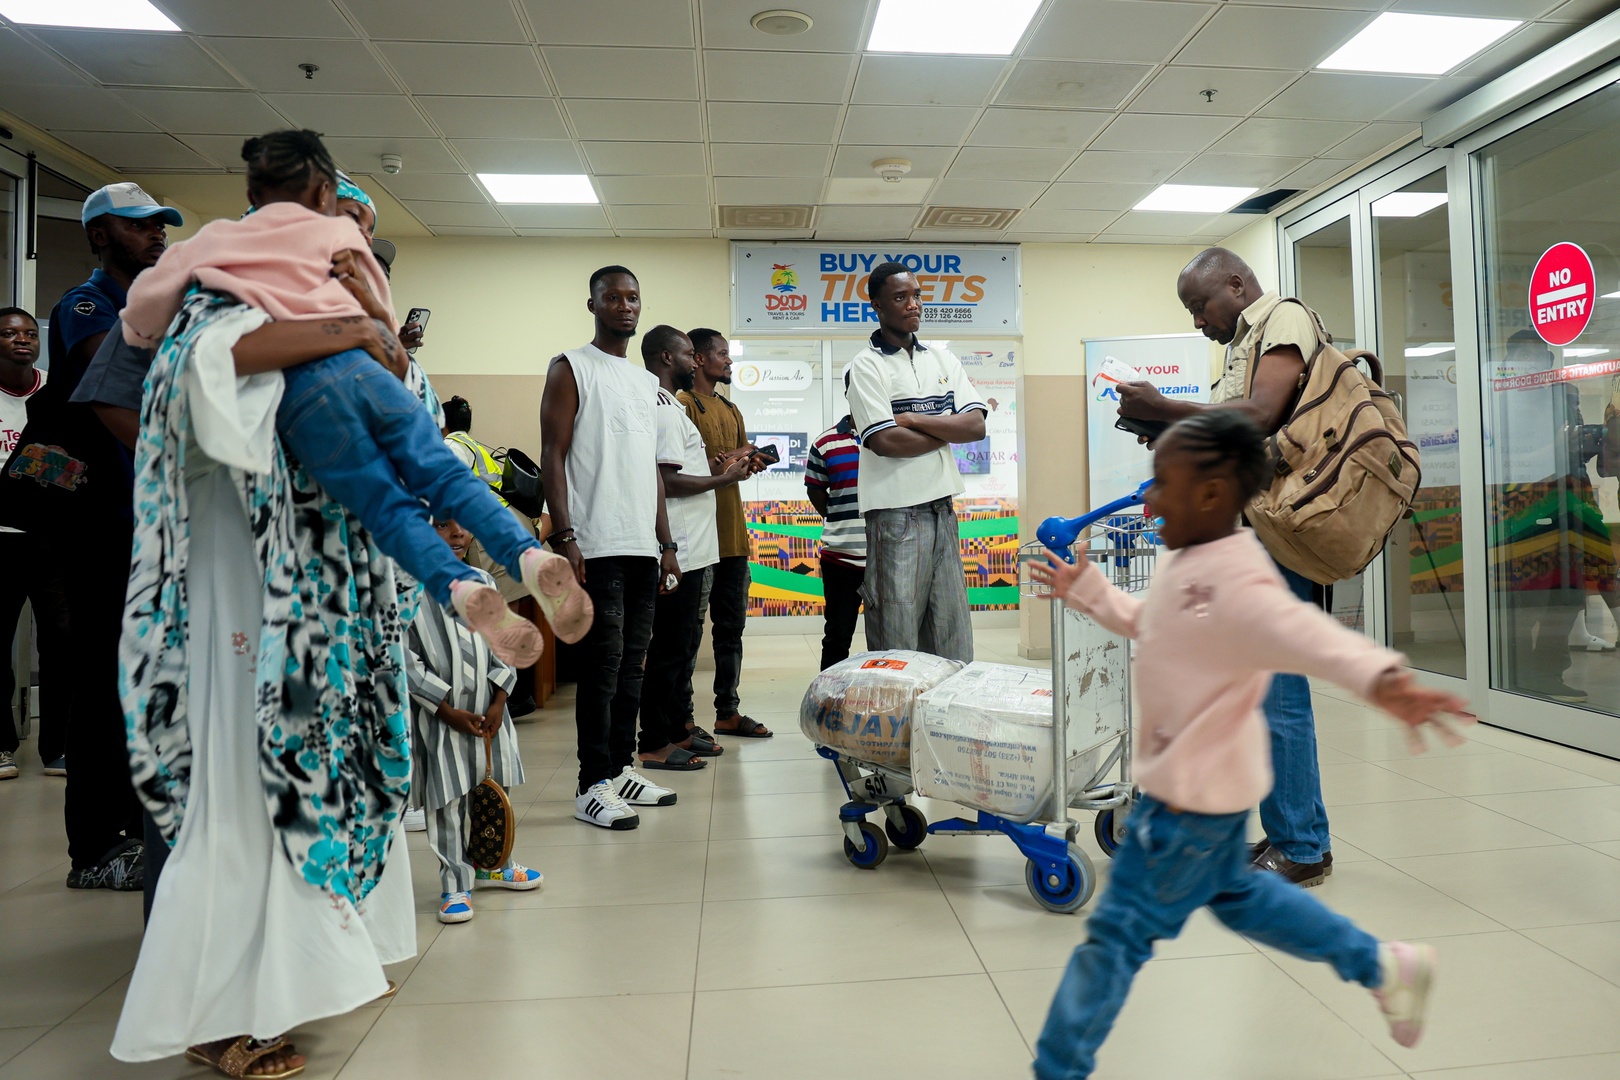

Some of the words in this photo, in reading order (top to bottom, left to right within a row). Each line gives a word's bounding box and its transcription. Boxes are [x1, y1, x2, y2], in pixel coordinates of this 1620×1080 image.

[820, 253, 877, 273] BUY
[1549, 267, 1571, 288] NO
[820, 274, 987, 302] TICETS
[765, 294, 807, 311] DODI
[821, 302, 880, 323] HER
[1537, 297, 1588, 325] ENTRY
[762, 369, 789, 382] Passion
[789, 369, 804, 381] Air
[1145, 365, 1180, 375] YOUR
[1157, 384, 1199, 395] nzania
[966, 451, 1005, 462] QATAR
[984, 750, 997, 759] 507
[998, 751, 1020, 761] (+233)
[1022, 755, 1034, 764] Tel:
[998, 771, 1019, 780] Africa.
[1020, 774, 1036, 783] West
